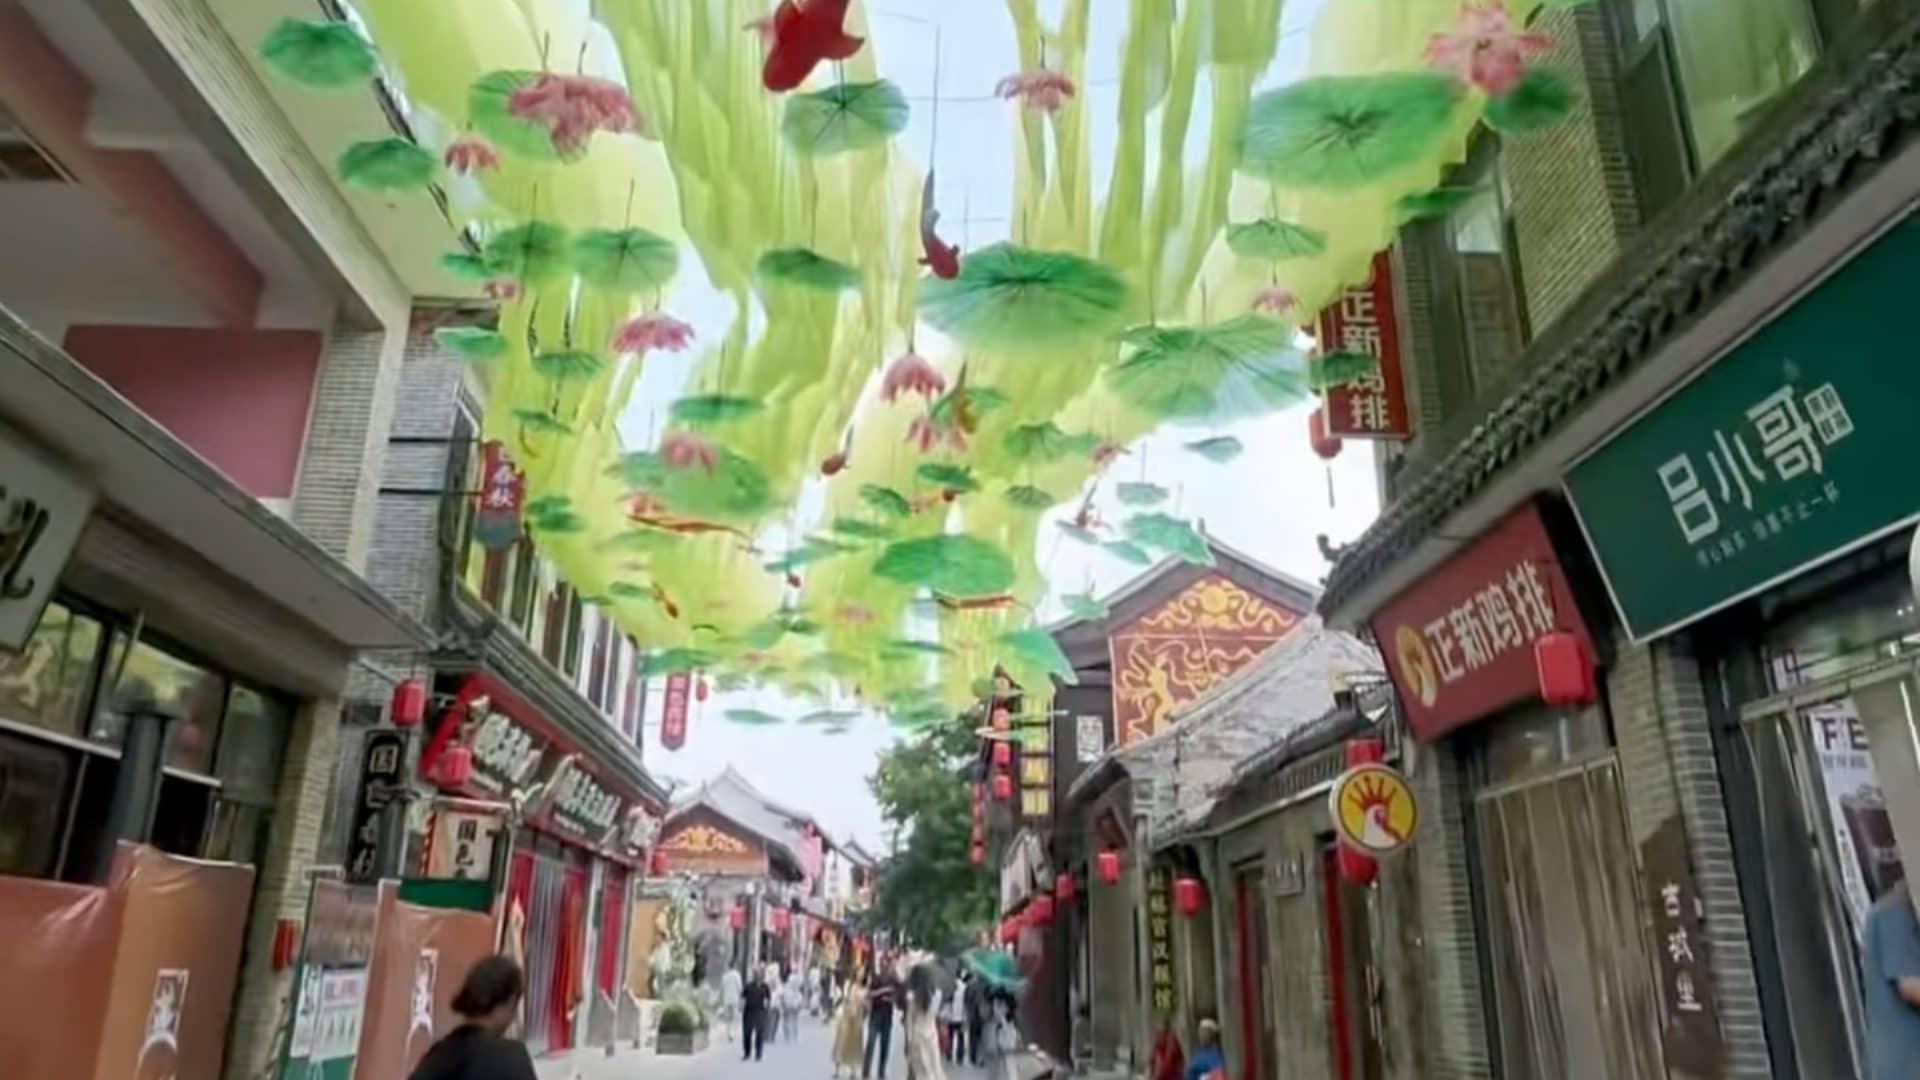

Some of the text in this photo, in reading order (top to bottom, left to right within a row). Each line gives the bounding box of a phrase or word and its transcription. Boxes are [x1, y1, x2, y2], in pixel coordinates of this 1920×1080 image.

[1656, 384, 1823, 544] 吕小哥
[1424, 559, 1555, 684] 正新鸡排
